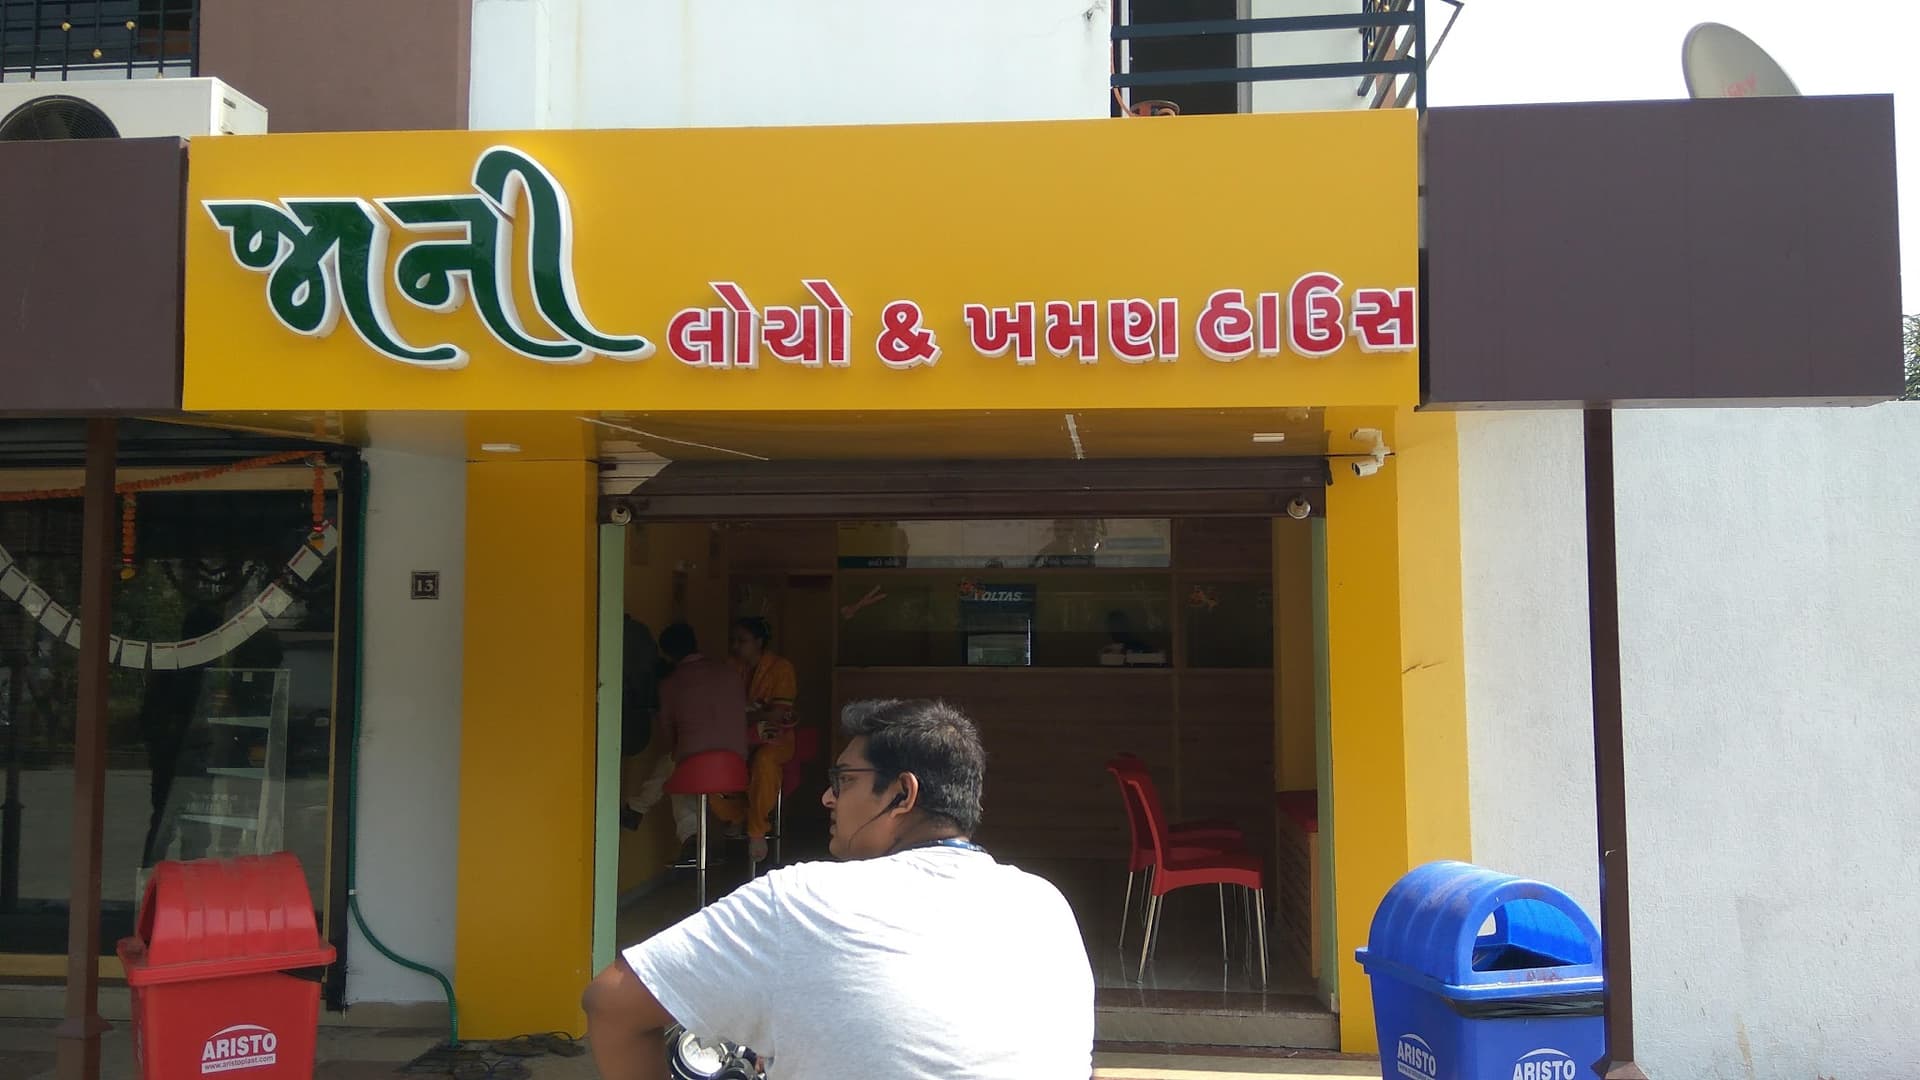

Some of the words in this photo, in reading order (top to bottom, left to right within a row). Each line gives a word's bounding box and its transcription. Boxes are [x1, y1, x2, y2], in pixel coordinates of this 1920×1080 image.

[201, 145, 656, 369] જાની
[667, 280, 853, 368] લોચો
[877, 300, 942, 368] &
[964, 299, 1178, 365] ખમણ
[1195, 271, 1416, 361] હાઉસ
[418, 580, 434, 592] 13
[203, 1033, 277, 1060] ARISTO
[1396, 1040, 1437, 1077] ARISTO
[1513, 1060, 1576, 1080] ARISTO
